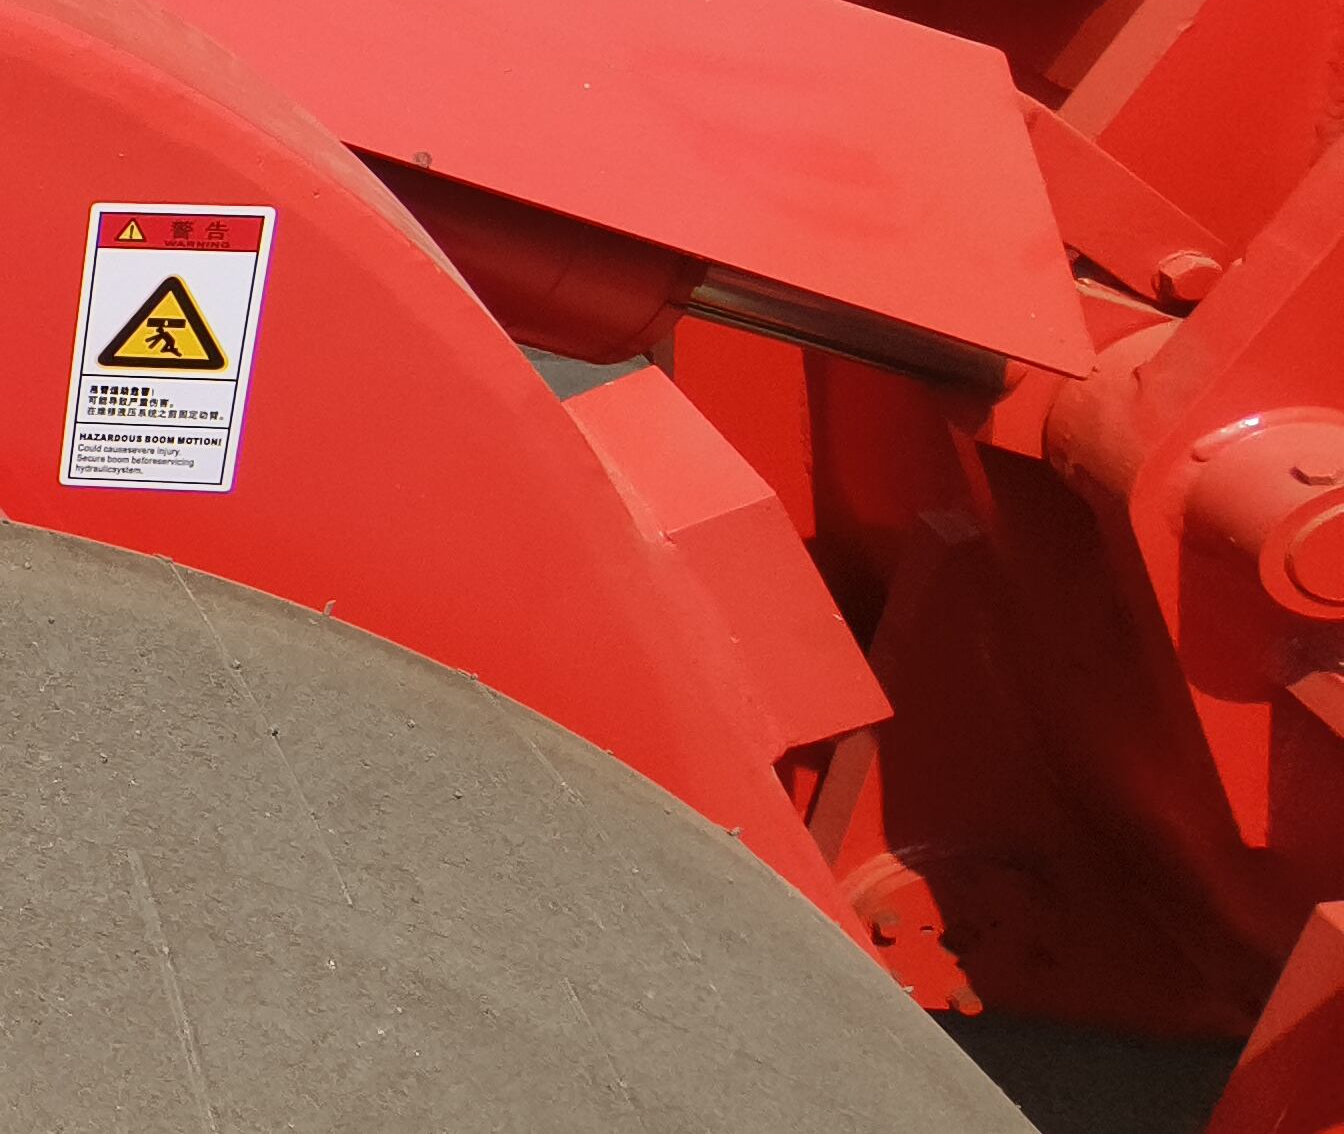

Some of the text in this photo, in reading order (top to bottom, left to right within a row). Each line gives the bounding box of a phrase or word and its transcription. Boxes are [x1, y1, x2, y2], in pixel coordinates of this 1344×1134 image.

[172, 220, 230, 240] 警告
[164, 240, 231, 249] WARNING
[79, 433, 223, 446] HAZARDOUS BOOM MOTION!
[77, 444, 102, 453] Could
[76, 454, 105, 463] Secure
[107, 455, 129, 464] boom
